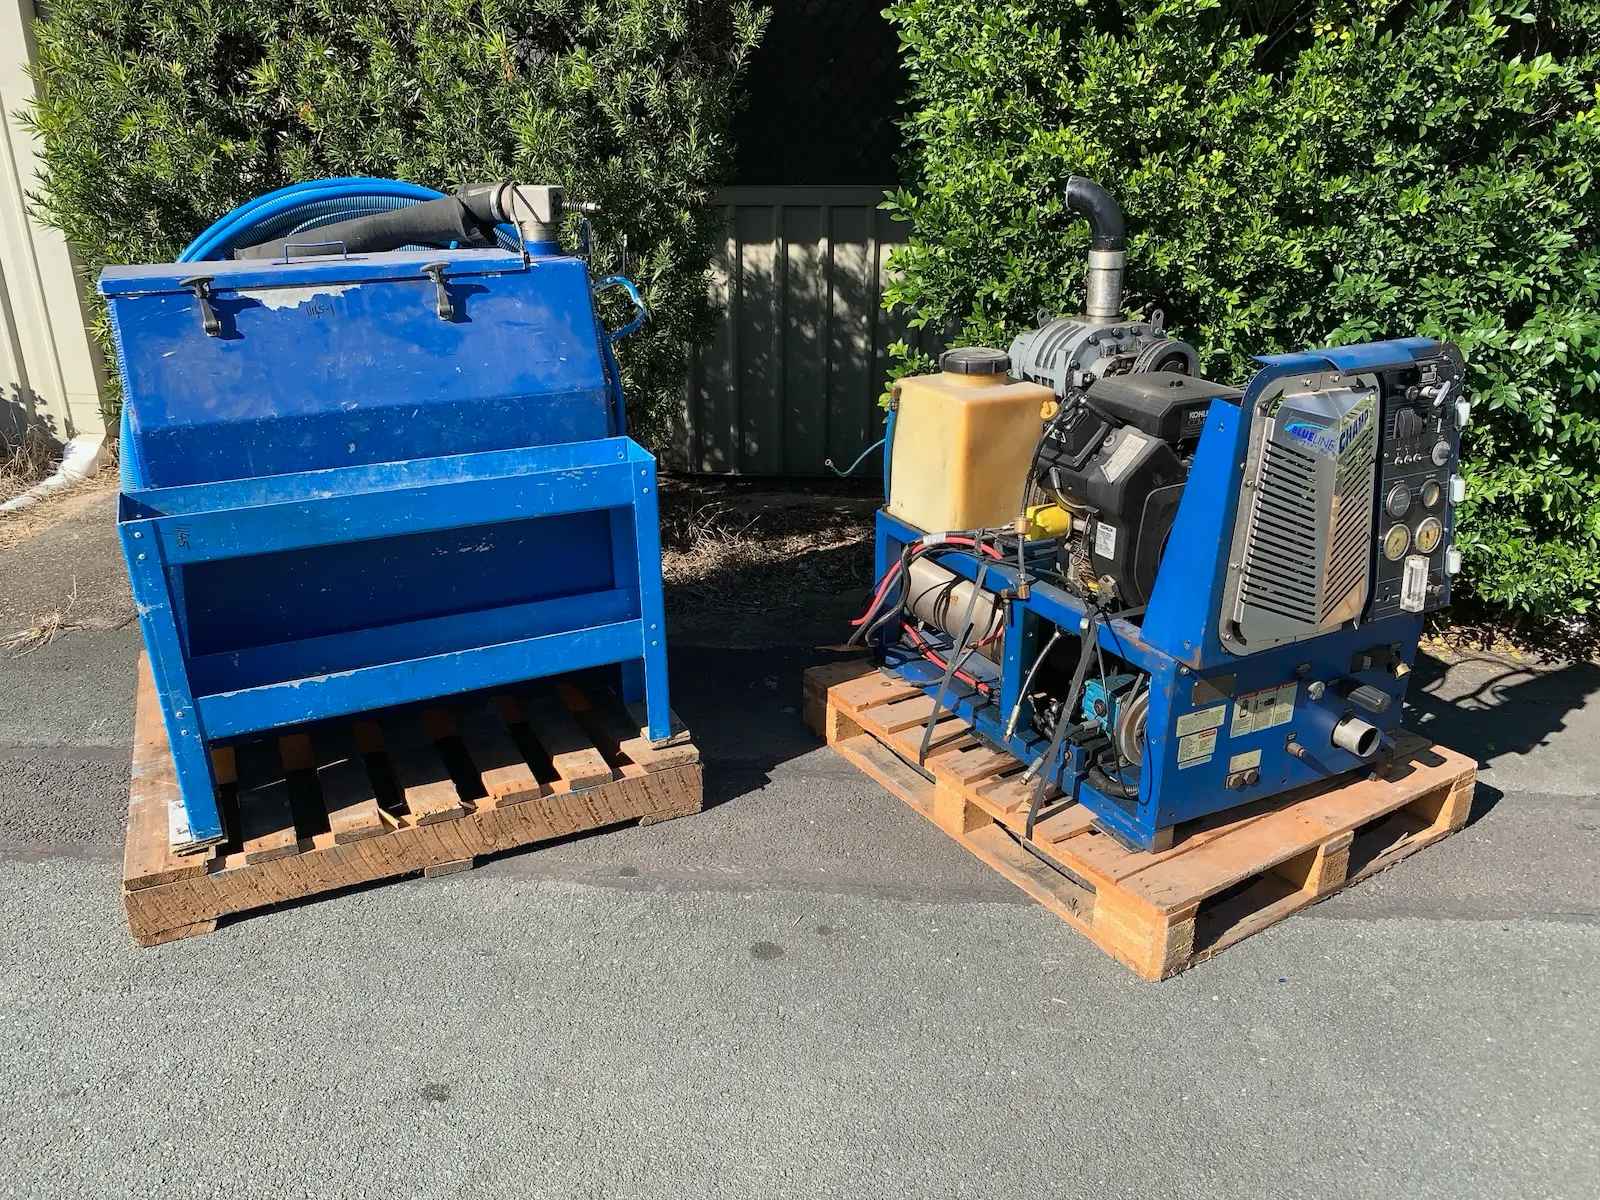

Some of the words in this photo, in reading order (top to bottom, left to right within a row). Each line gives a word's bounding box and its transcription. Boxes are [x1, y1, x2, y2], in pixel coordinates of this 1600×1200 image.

[1189, 410, 1210, 419] KOHLE
[1291, 425, 1336, 452] BLUELINE
[1339, 408, 1369, 454] CHAMP
